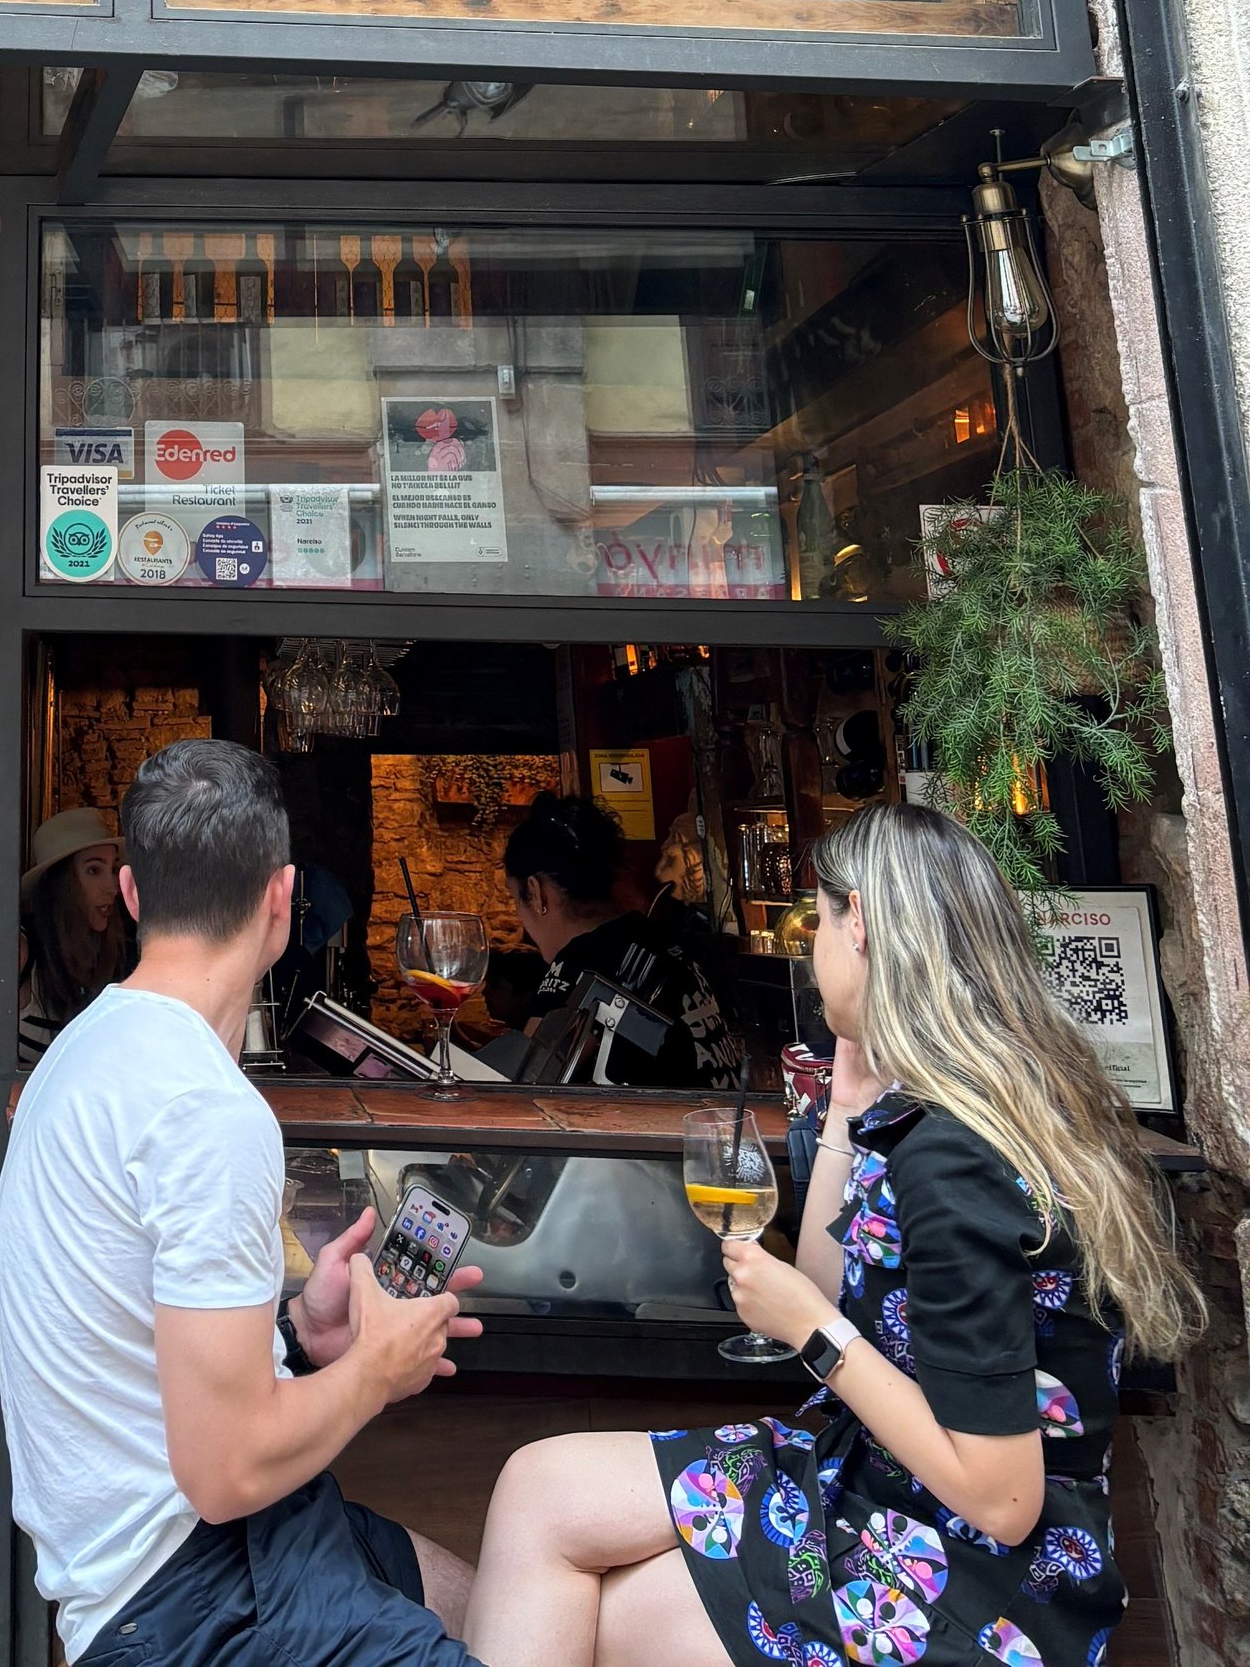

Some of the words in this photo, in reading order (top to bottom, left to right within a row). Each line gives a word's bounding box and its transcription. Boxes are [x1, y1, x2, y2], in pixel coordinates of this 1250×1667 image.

[64, 442, 124, 464] VISA
[155, 444, 236, 463] Edenred
[47, 473, 112, 486] Tripadvisor
[202, 485, 236, 495] Ticket
[57, 496, 100, 507] Choice
[172, 495, 236, 506] Restaurant
[296, 495, 338, 503] Tripadvisor
[68, 560, 90, 568] 2021
[140, 569, 166, 580] 2018
